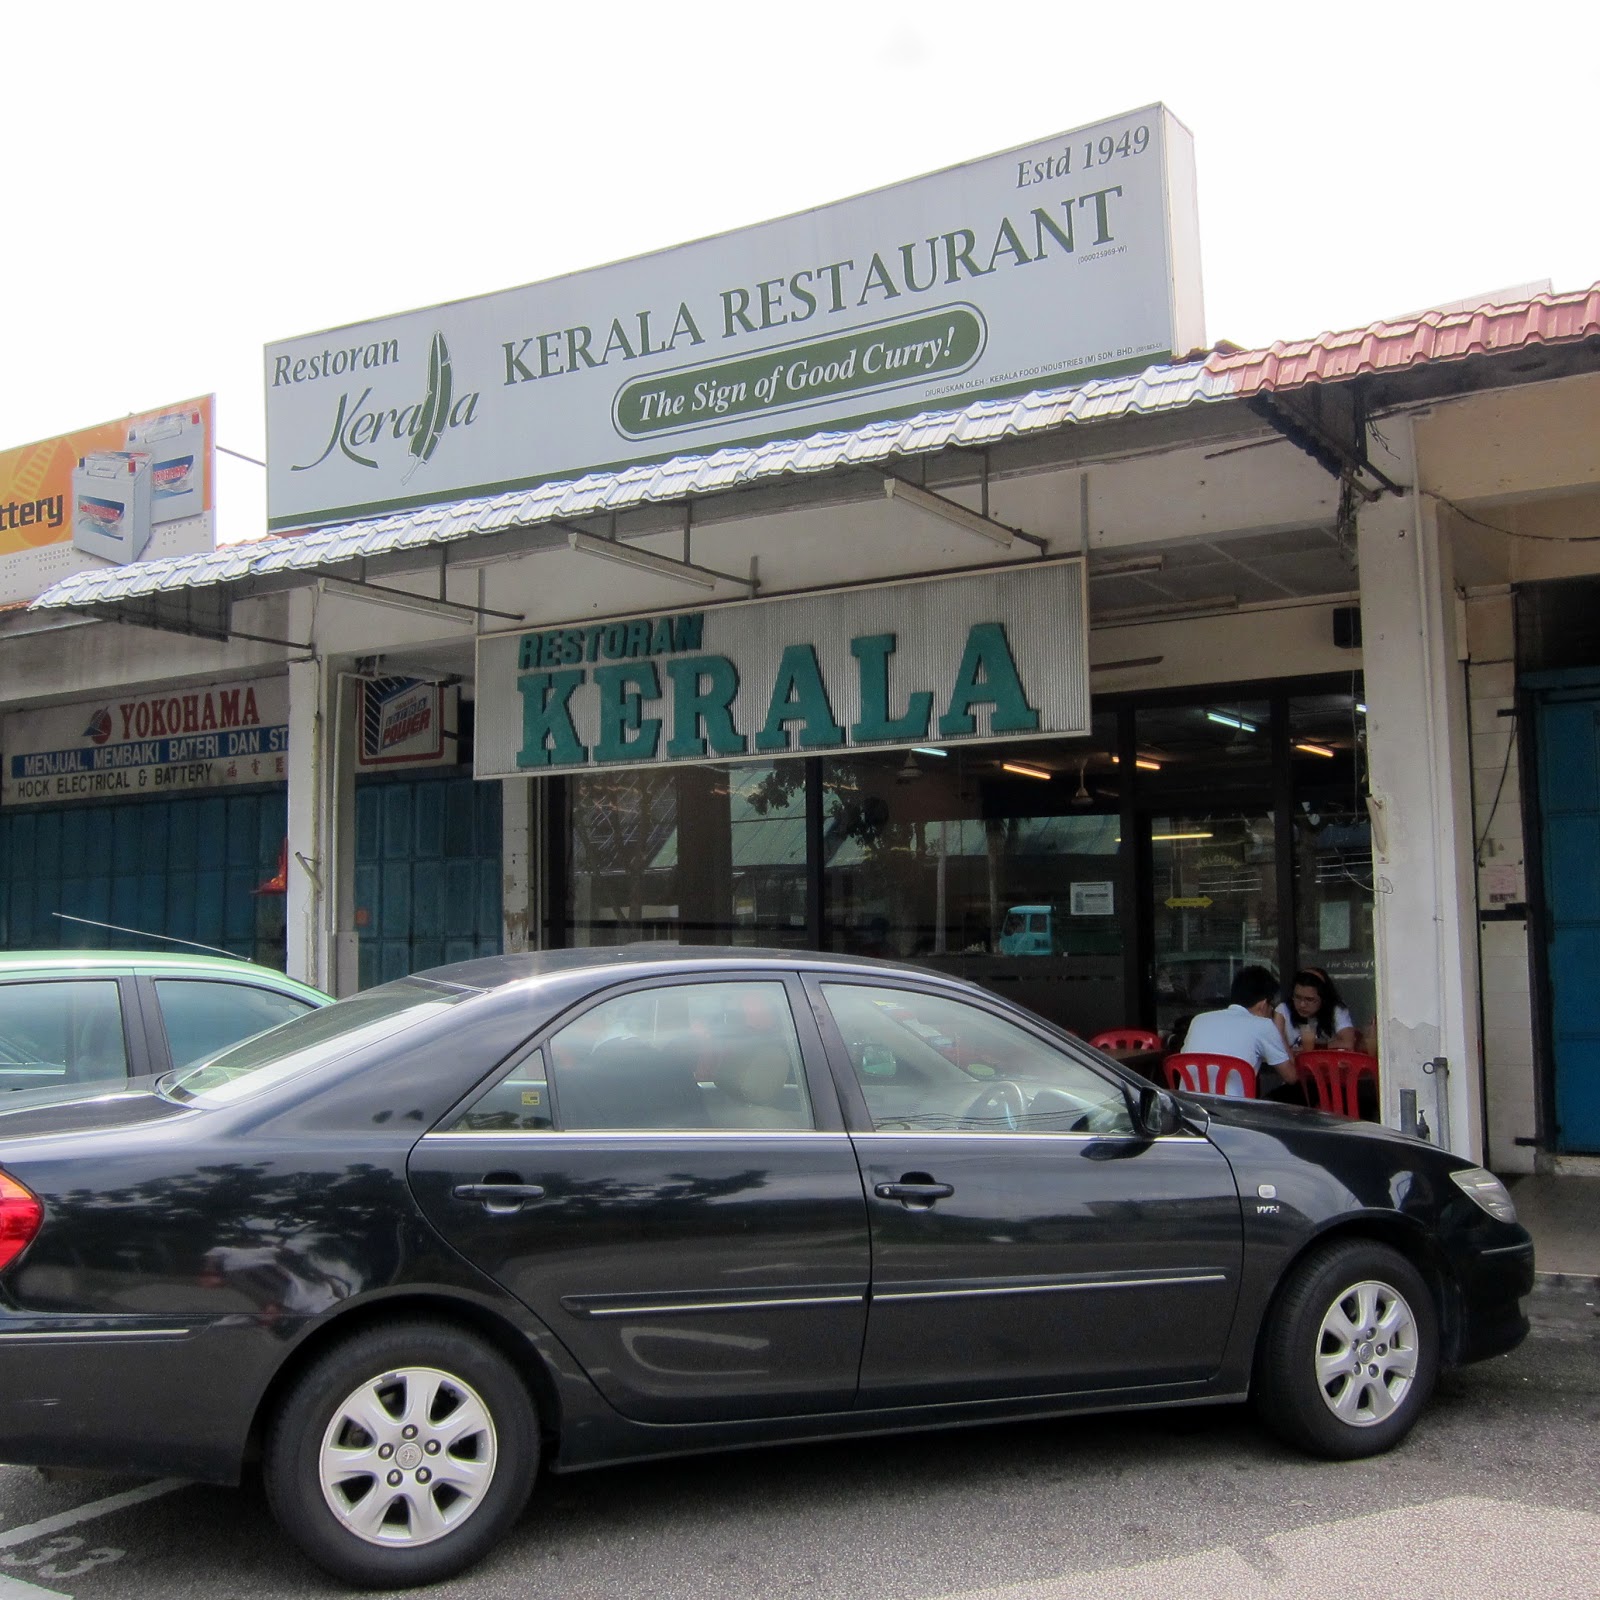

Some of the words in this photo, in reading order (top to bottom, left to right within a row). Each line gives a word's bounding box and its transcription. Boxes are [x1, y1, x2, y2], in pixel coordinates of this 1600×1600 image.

[1016, 147, 1071, 188] Estd
[1082, 125, 1150, 170] 1949
[502, 301, 705, 386] KERALA
[719, 185, 1123, 338] RESTAURANT
[272, 338, 399, 387] Restoran
[638, 394, 684, 421] The
[691, 380, 746, 413] Sign
[754, 365, 782, 403] of
[786, 349, 856, 390] Good
[862, 326, 956, 372] Curry!
[925, 382, 964, 397] DIURUSKAN
[965, 378, 984, 389] OLEH
[989, 371, 1018, 384] KERALA
[1019, 366, 1039, 377] FOOD
[1041, 357, 1083, 372] INDUSTRIES
[1085, 355, 1096, 365] (M)
[1117, 346, 1135, 357] BHD.
[517, 611, 705, 670] RESTORAN
[119, 686, 260, 740] YOKOHAMA
[515, 621, 1041, 768] KERALA
[93, 743, 160, 768] MEMBAIKI
[168, 736, 219, 762] BATERI
[229, 729, 260, 754] DAN
[269, 726, 288, 751] ST
[18, 779, 49, 798] HOCK
[57, 769, 130, 795] ELECTRICAL
[138, 769, 148, 787] &
[154, 763, 213, 786] BATTERY
